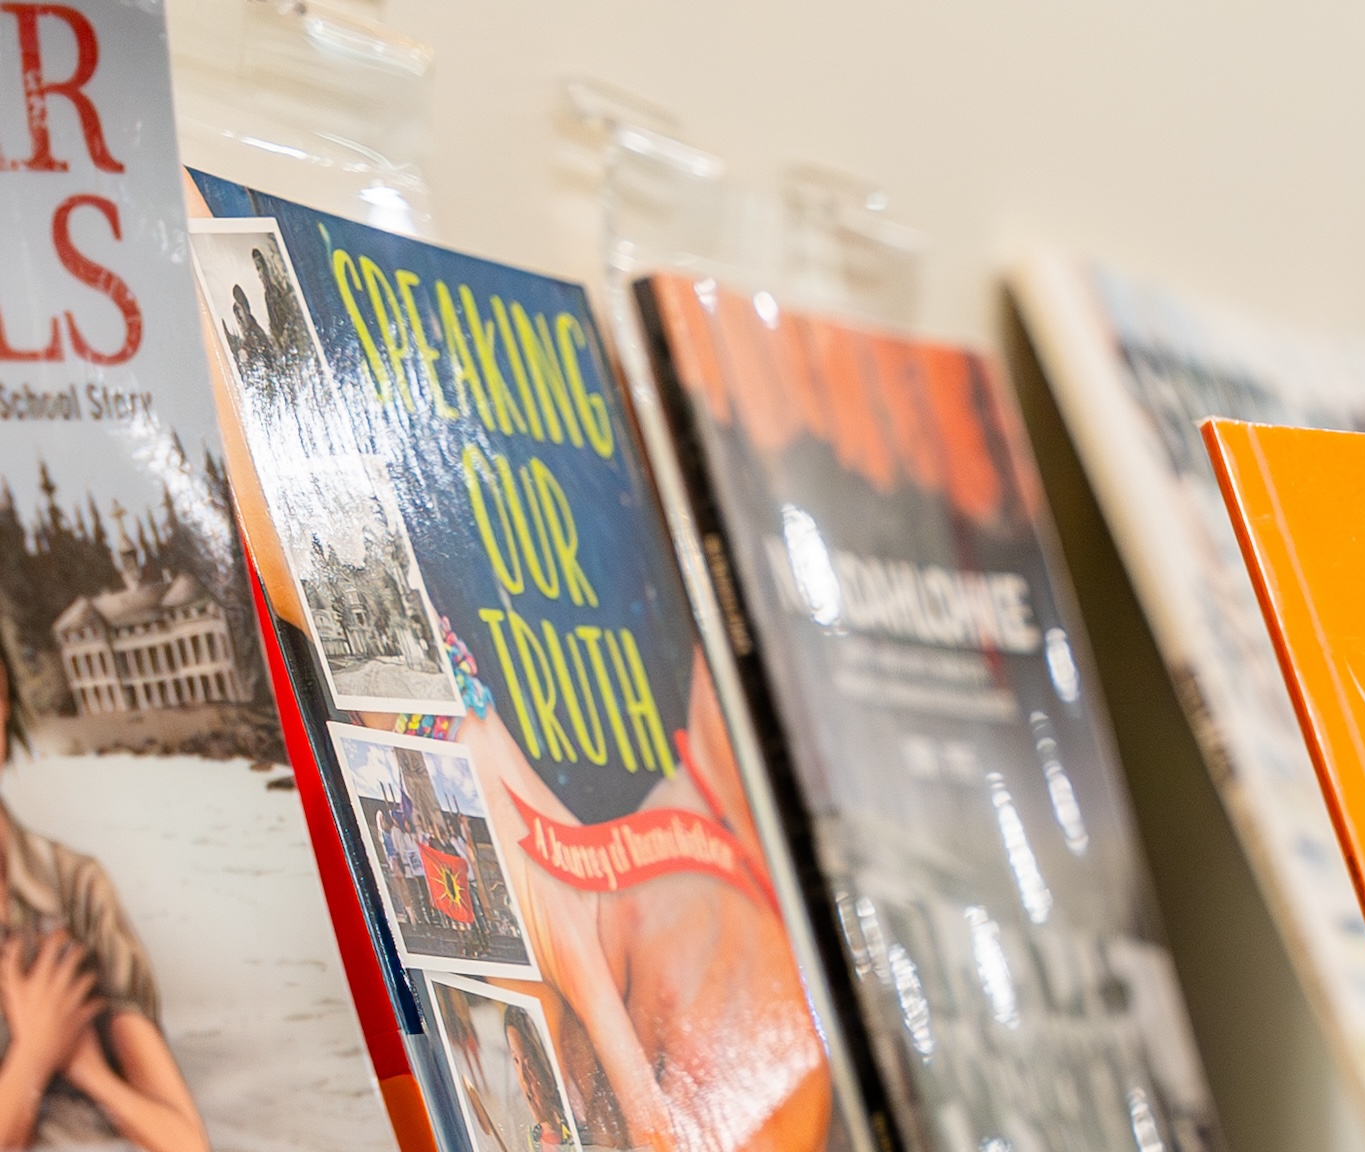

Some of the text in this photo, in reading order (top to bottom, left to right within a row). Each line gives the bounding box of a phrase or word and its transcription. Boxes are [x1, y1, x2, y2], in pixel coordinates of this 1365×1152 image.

[0, 2, 126, 174] R
[333, 248, 614, 459] SPEAKING
[462, 446, 599, 609] OUR
[479, 607, 677, 780] TRUTH
